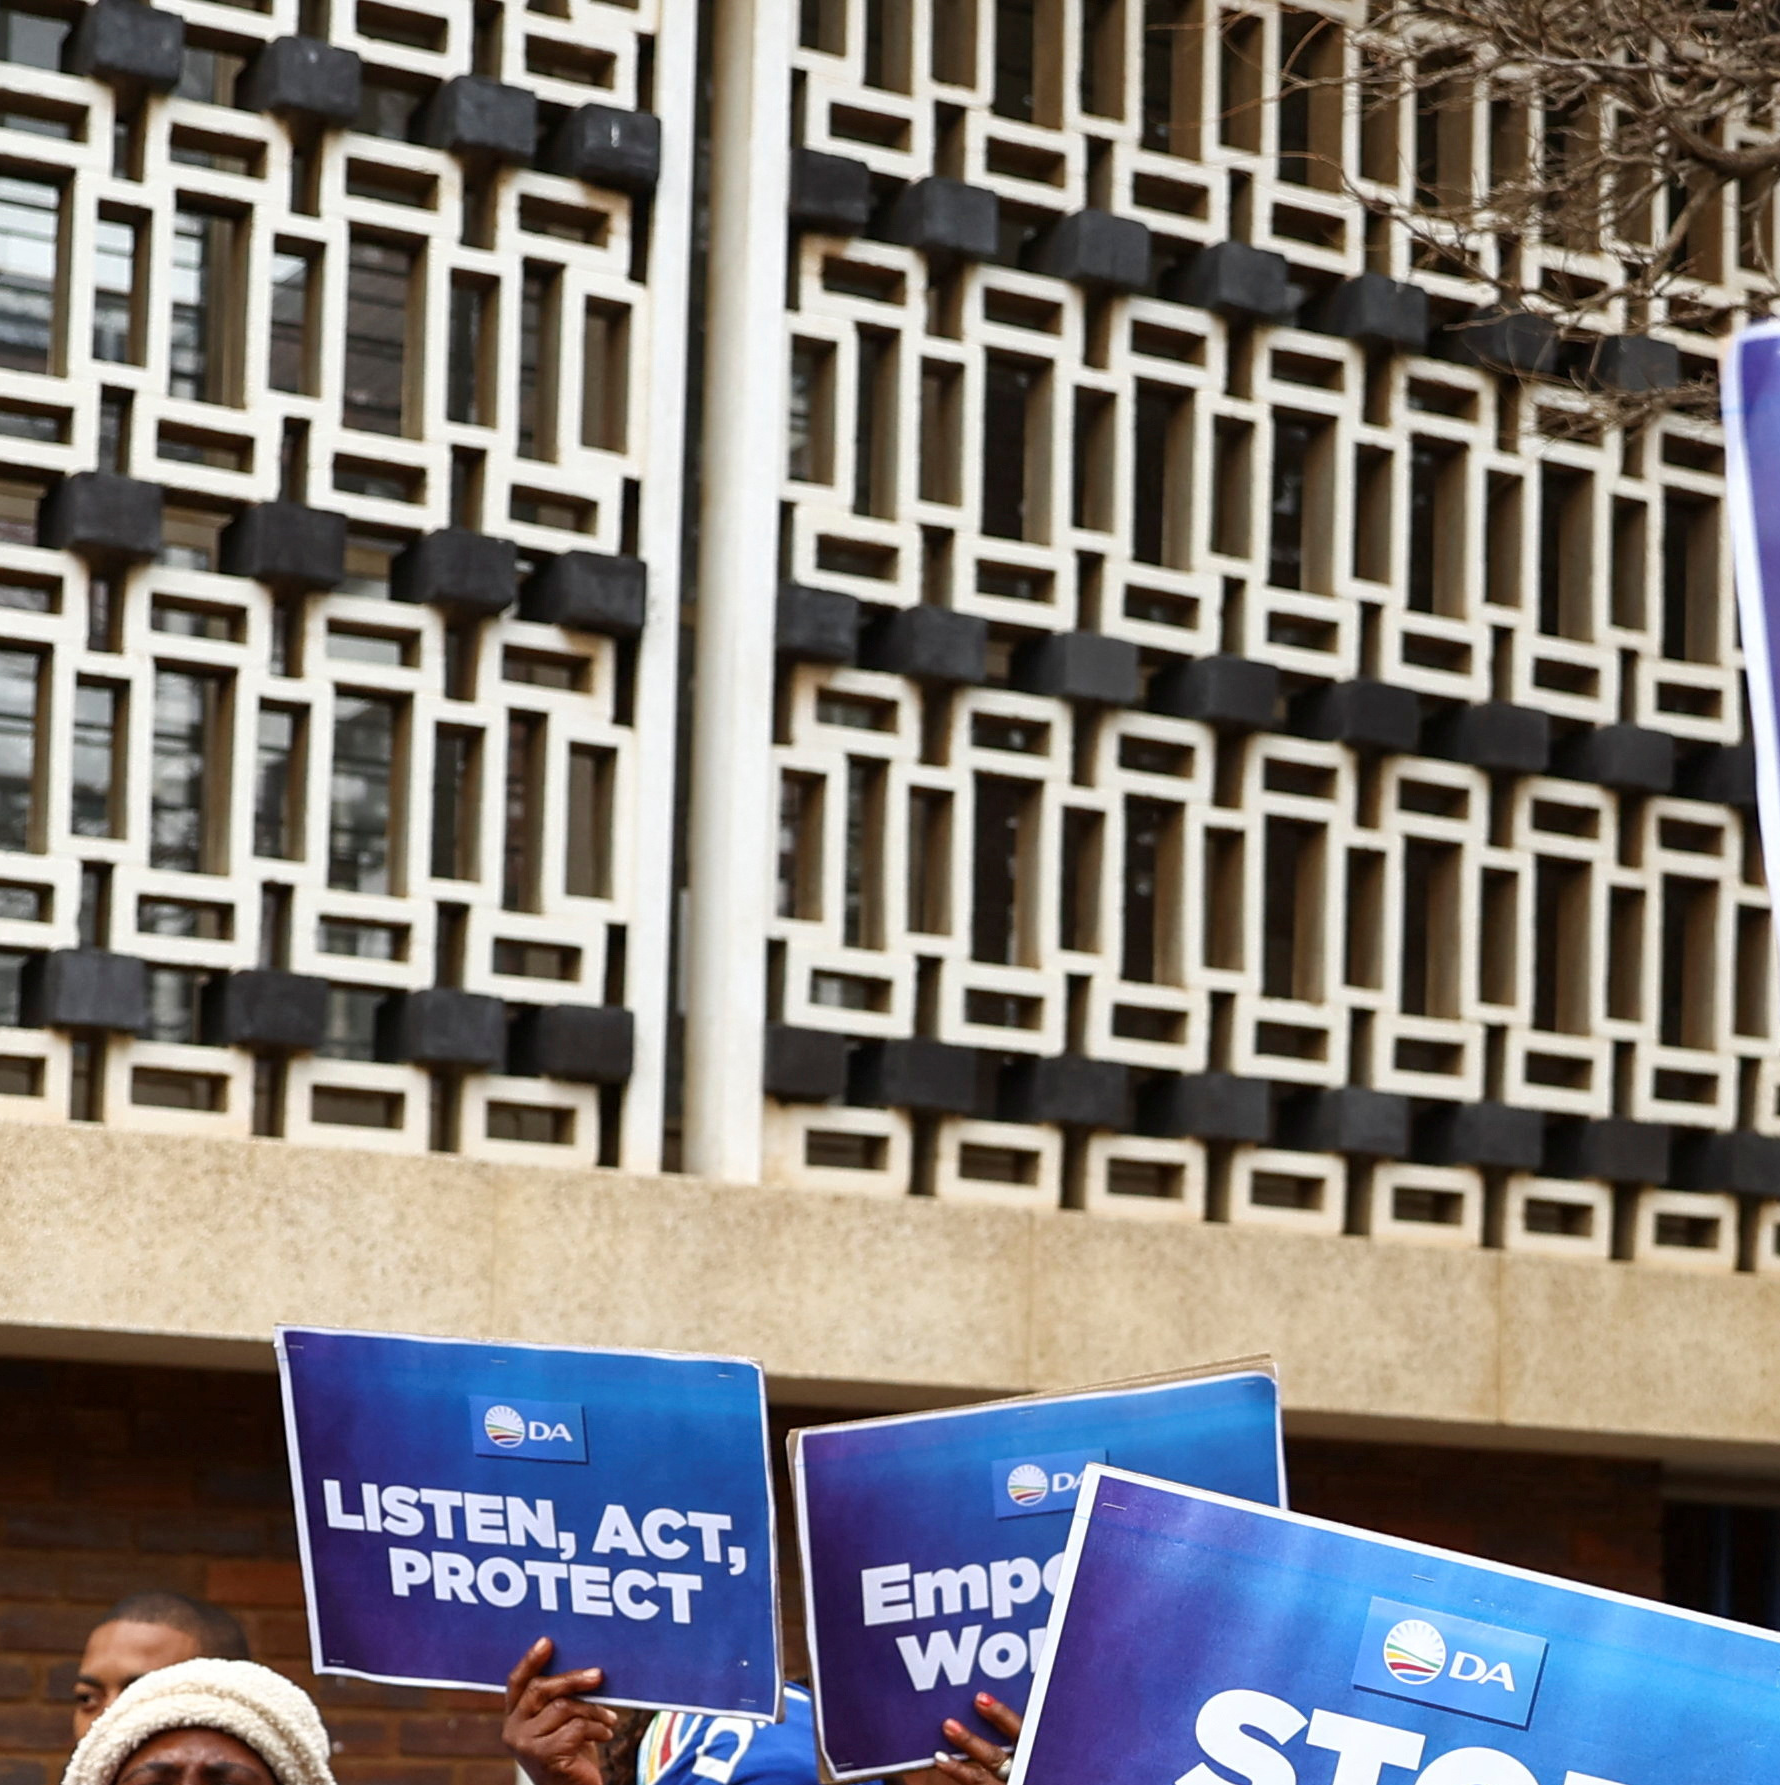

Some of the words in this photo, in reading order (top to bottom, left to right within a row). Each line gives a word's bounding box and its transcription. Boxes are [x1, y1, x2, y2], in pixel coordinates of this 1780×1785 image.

[528, 1422, 573, 1442] DA
[323, 1479, 579, 1563] LISTEN,
[593, 1503, 747, 1576] ACT,
[389, 1546, 703, 1625] PROTECT
[1448, 1650, 1516, 1694] DA
